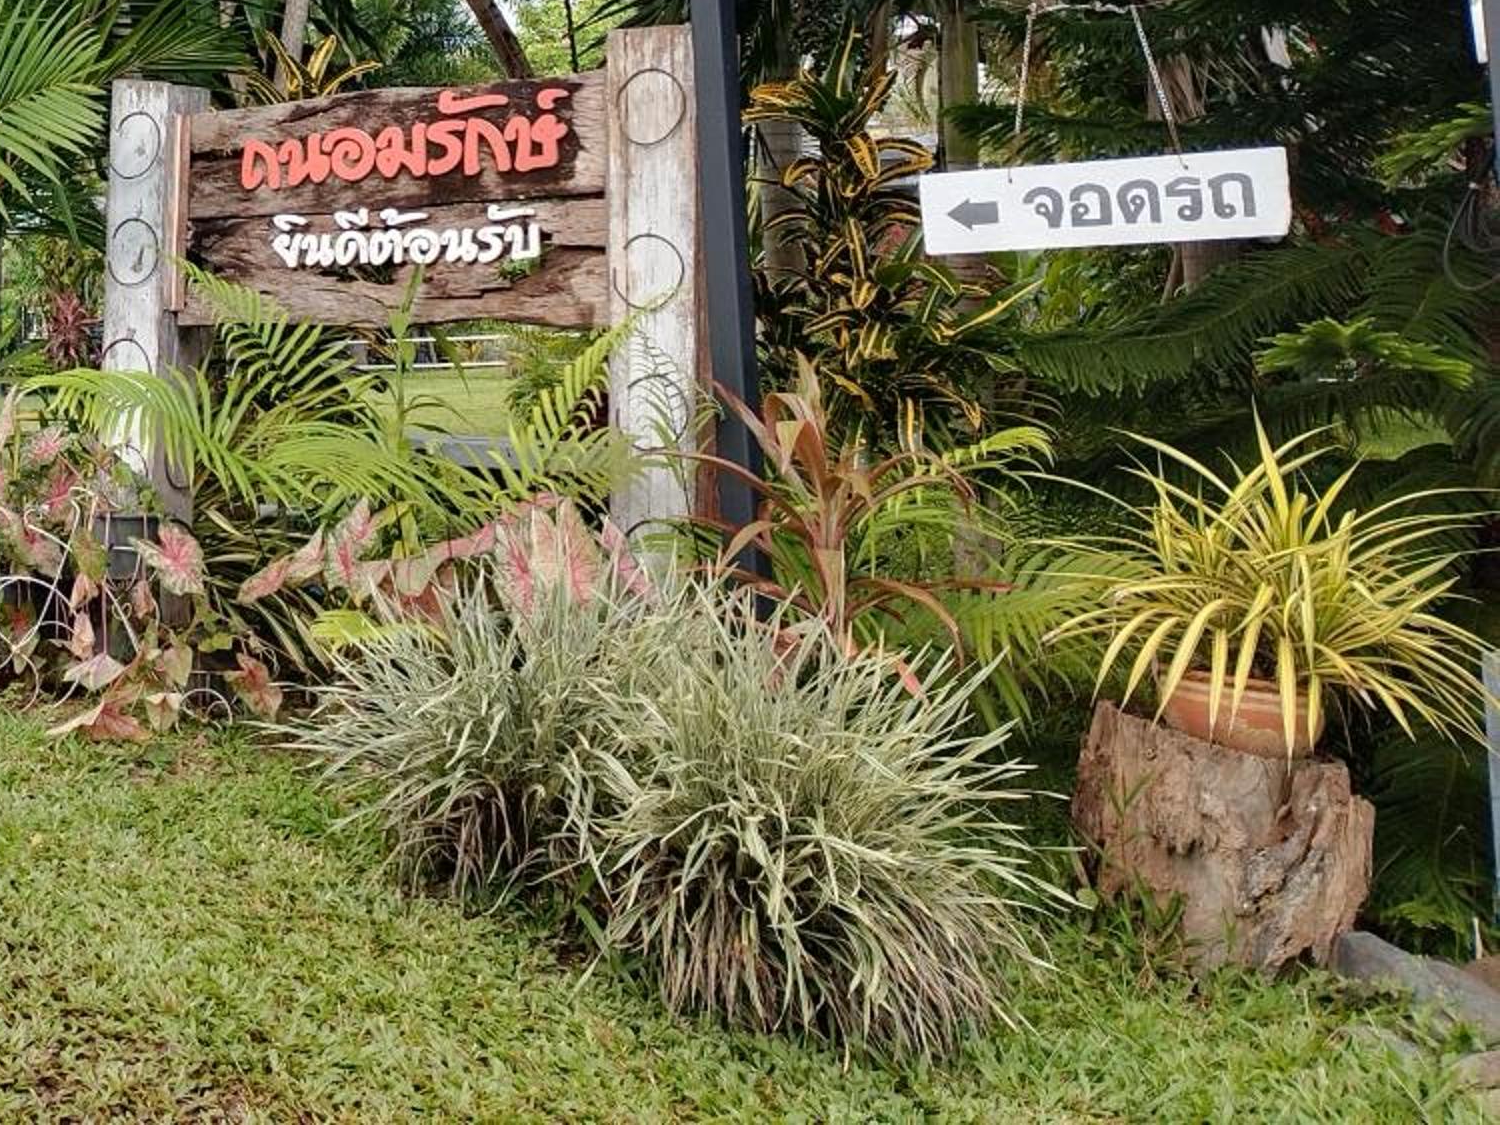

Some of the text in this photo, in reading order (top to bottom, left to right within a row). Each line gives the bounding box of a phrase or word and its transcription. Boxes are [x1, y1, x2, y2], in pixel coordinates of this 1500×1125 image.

[240, 89, 569, 190] ถนอมรักษ์
[1022, 172, 1257, 229] จอดรถ
[272, 204, 542, 268] ยินดีต้อนรับ
